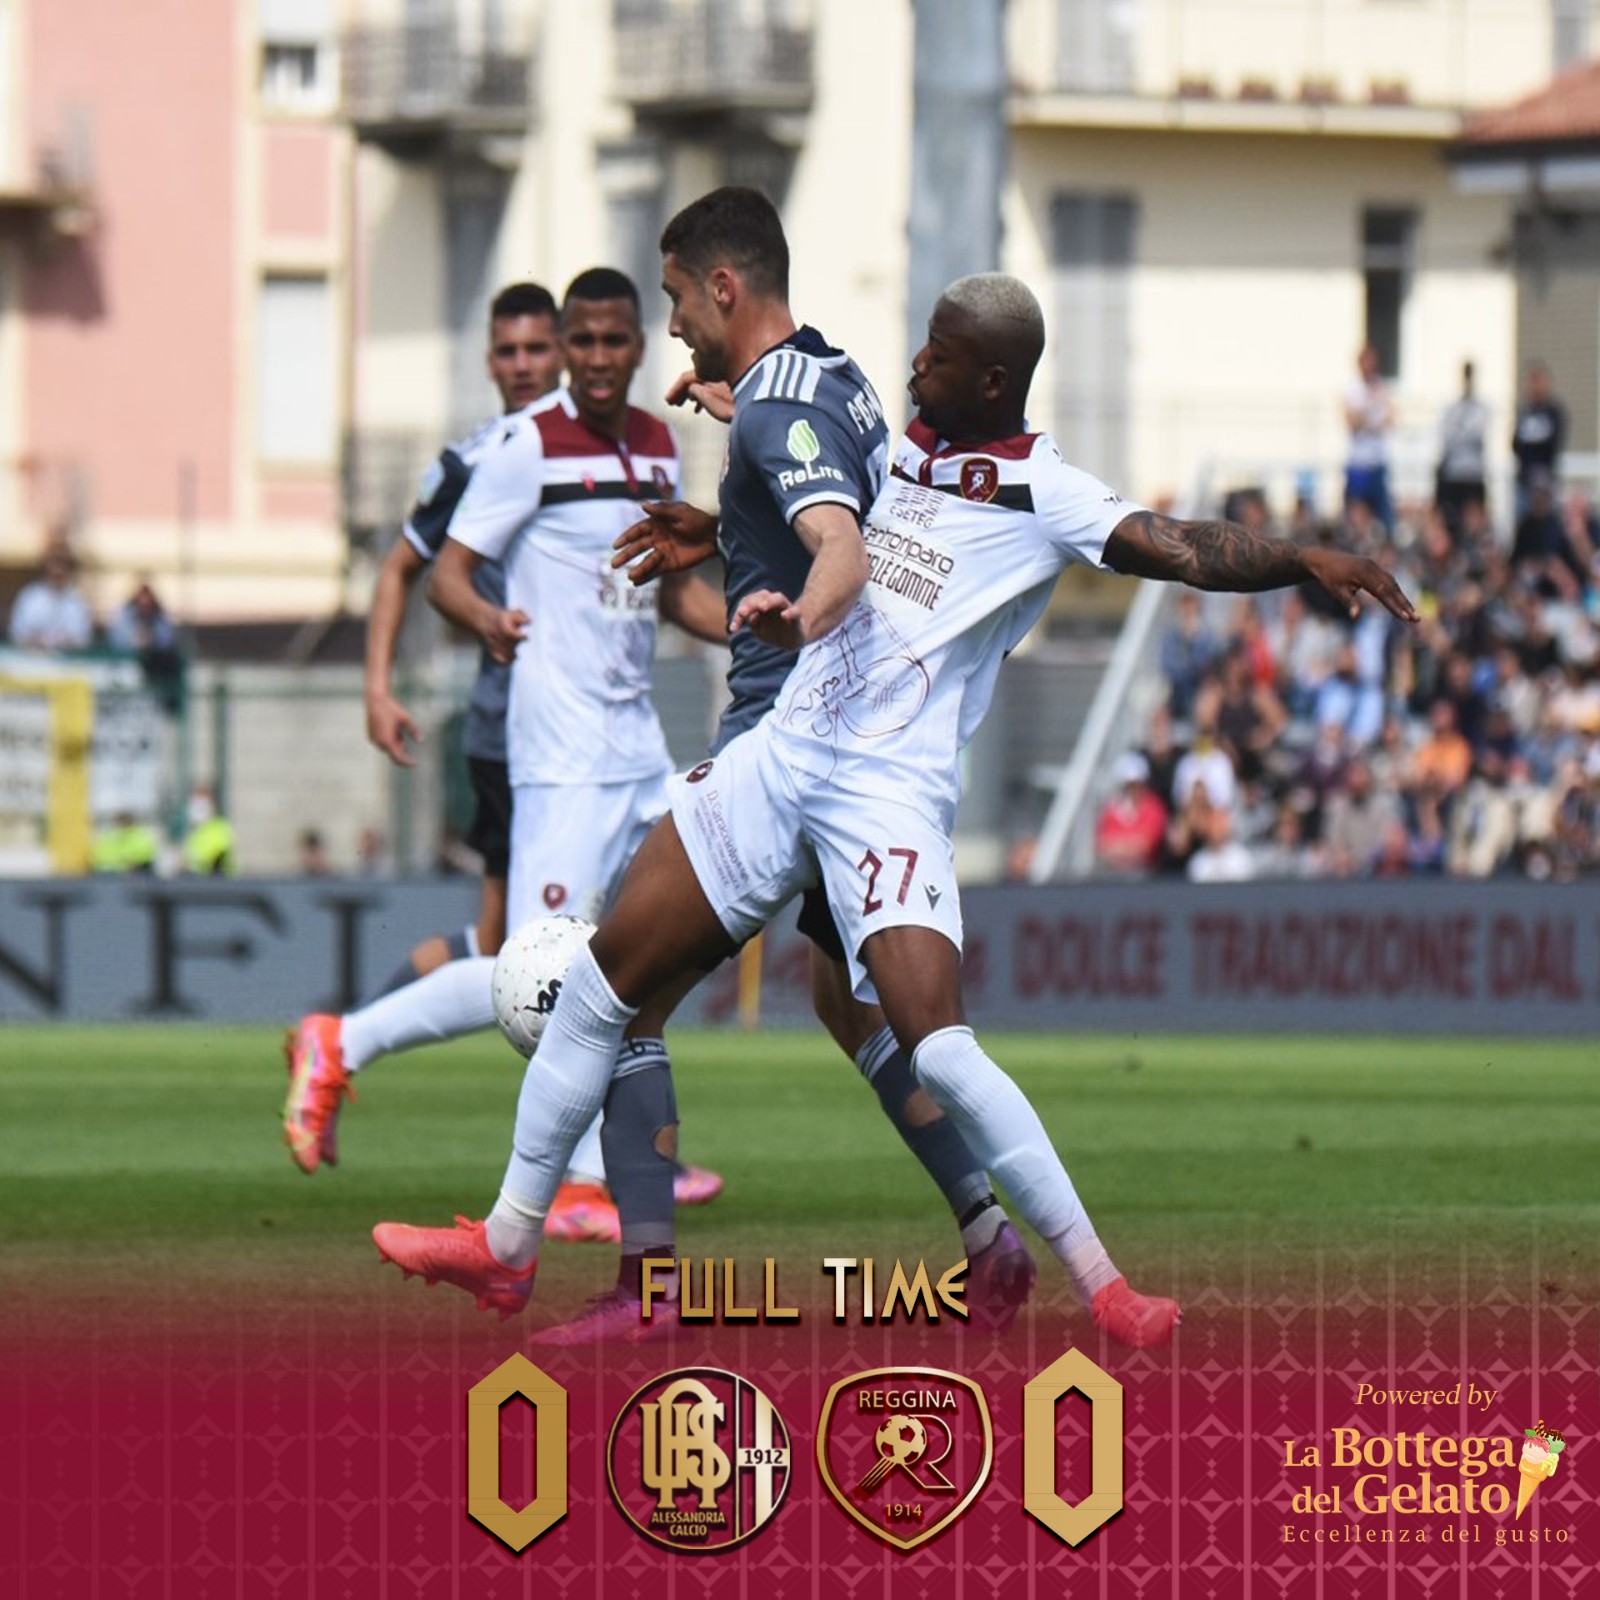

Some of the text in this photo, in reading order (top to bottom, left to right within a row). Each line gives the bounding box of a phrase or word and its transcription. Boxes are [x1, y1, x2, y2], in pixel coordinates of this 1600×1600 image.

[857, 847, 919, 917] 27
[1015, 911, 1165, 999] DOLCE
[1190, 911, 1477, 999] TRADIZIONE
[1489, 911, 1581, 1000] DAL
